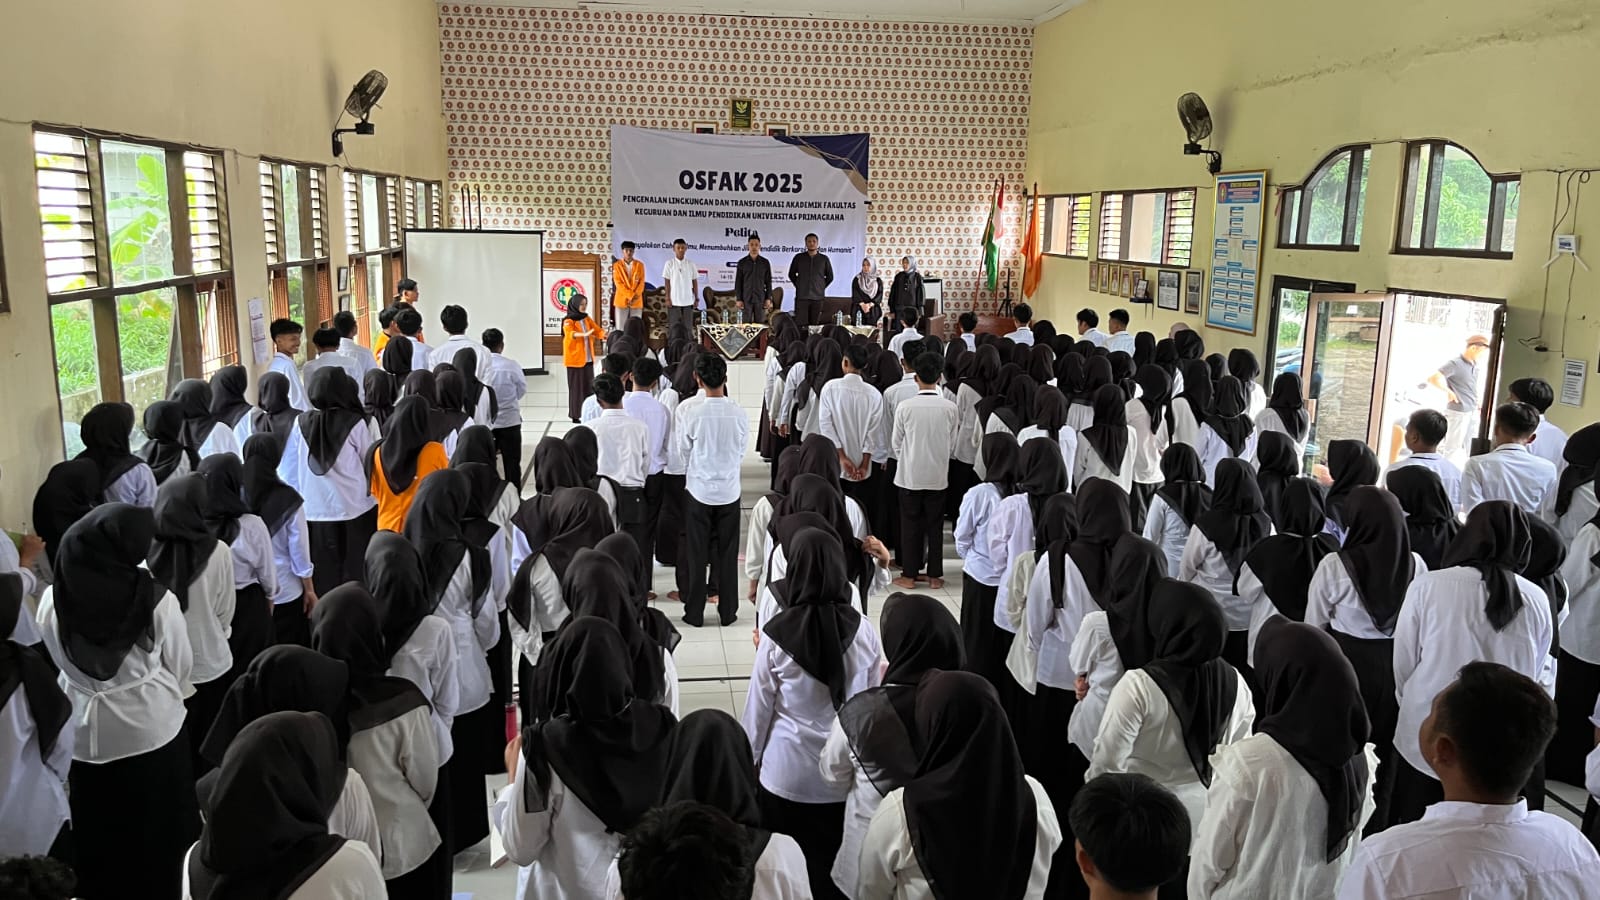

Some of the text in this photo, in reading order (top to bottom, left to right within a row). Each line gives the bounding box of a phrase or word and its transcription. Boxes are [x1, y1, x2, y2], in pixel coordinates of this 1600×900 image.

[679, 170, 802, 193] OSFAK 2025
[623, 195, 667, 203] PENGENALAN
[668, 197, 713, 205] LINGKUNGAN
[731, 200, 784, 208] TRANSFORMASI
[786, 201, 822, 209] AKADEMIK
[635, 208, 844, 221] KEGURUAN DAN ILMU PENDIDIKAN UNIVERSITAS PRIMAGRAHA
